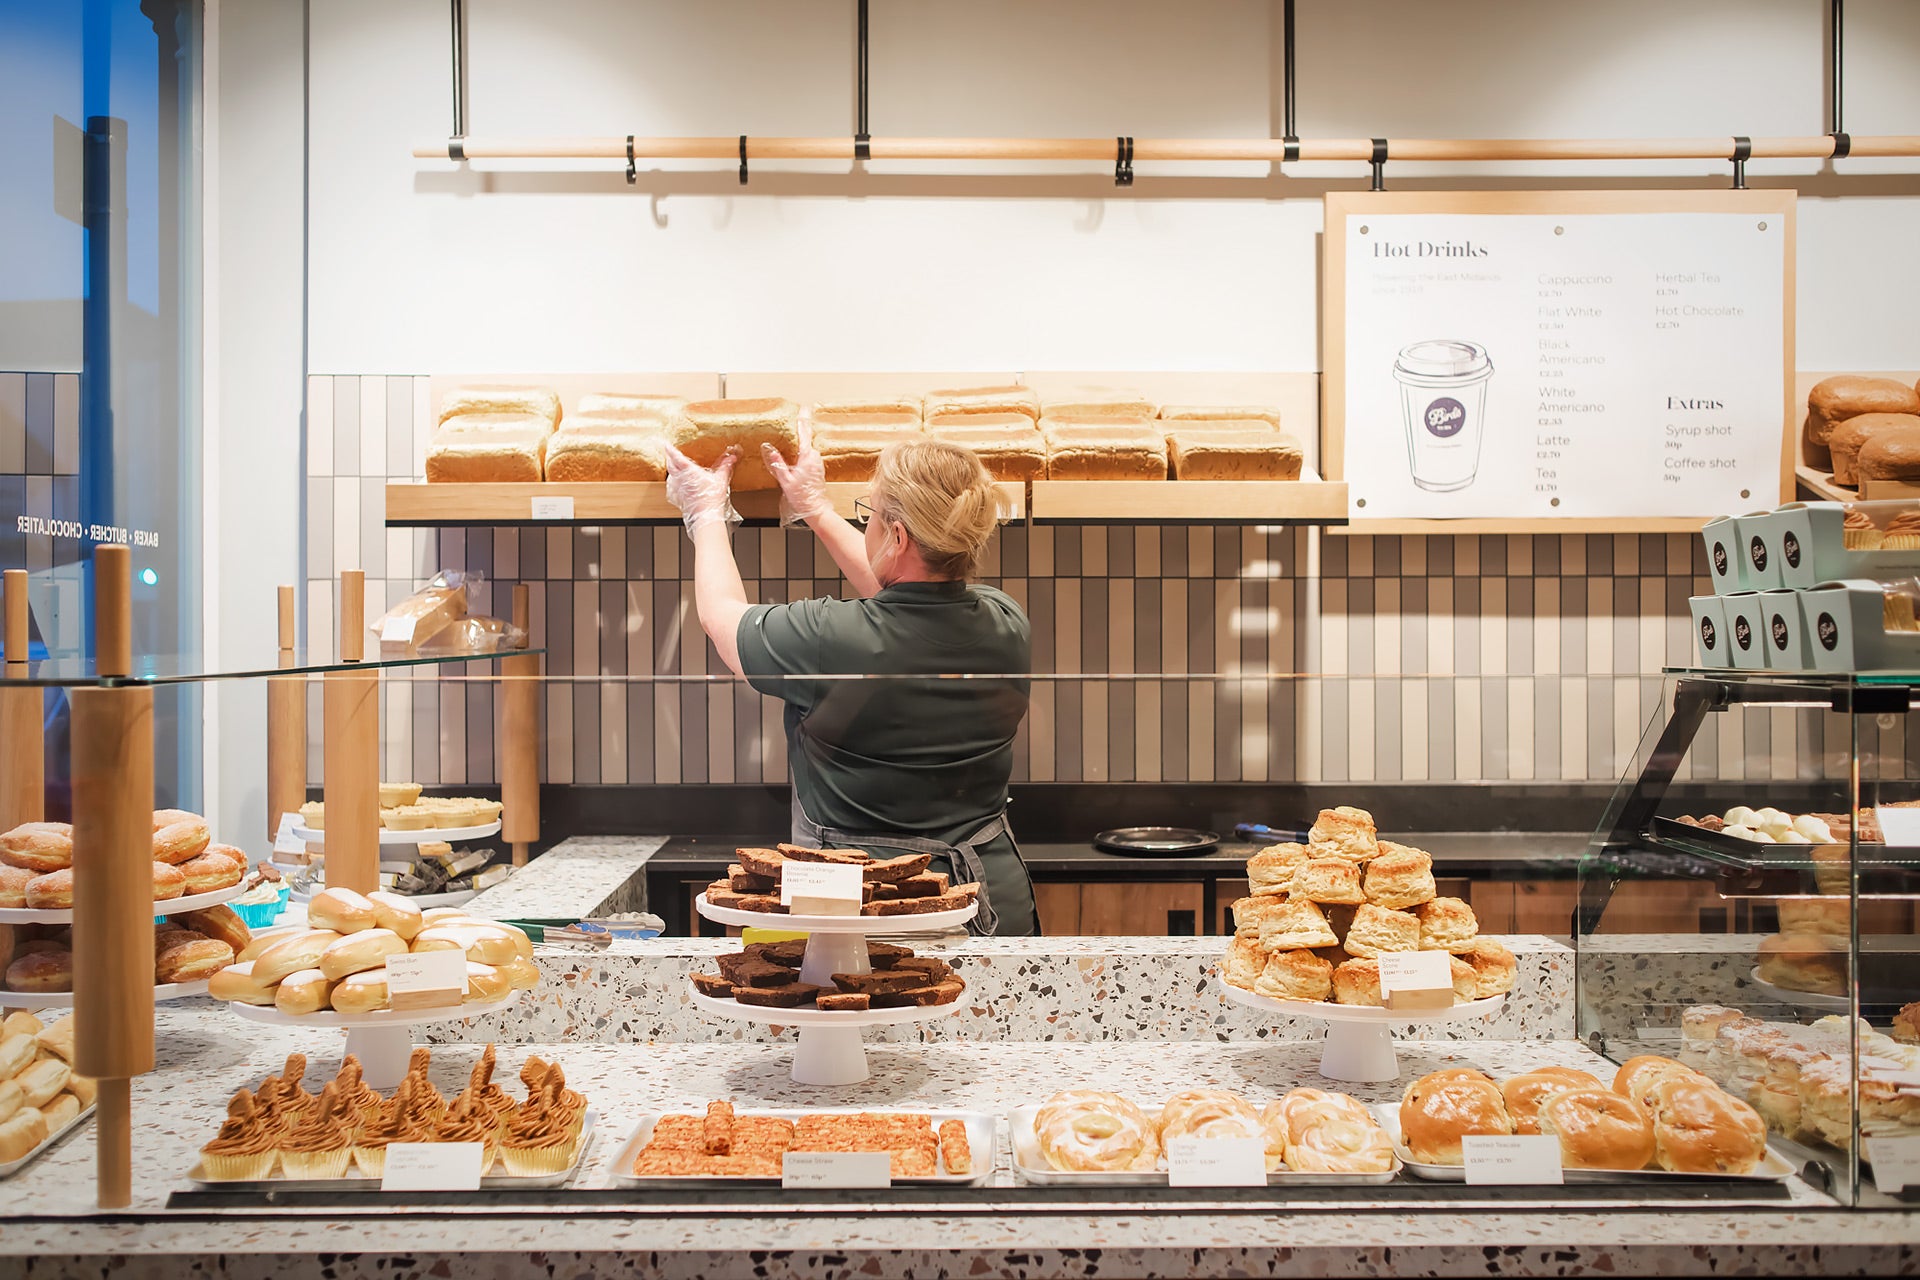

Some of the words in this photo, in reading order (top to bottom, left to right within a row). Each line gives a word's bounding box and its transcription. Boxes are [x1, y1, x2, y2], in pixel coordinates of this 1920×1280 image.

[1373, 241, 1411, 258] Hot
[1418, 240, 1489, 258] Drinks
[1537, 273, 1614, 287] Cappuccino
[1655, 272, 1697, 283] Herbal
[1699, 271, 1721, 283] Tea
[1538, 306, 1561, 318] Flat
[1565, 306, 1603, 318] White
[1656, 305, 1680, 316] Hot
[1682, 304, 1744, 316] Chocolate
[1538, 338, 1571, 350] Black
[1539, 353, 1607, 366] Americano
[1538, 386, 1577, 399] White
[1538, 401, 1606, 413] Americano
[1667, 396, 1725, 411] Extras
[1665, 424, 1702, 438] Syrup
[1705, 424, 1733, 436] shot
[1536, 434, 1571, 446] Latte
[1664, 456, 1706, 469] Coffee
[1709, 456, 1737, 469] shot
[1535, 466, 1557, 479] Tea
